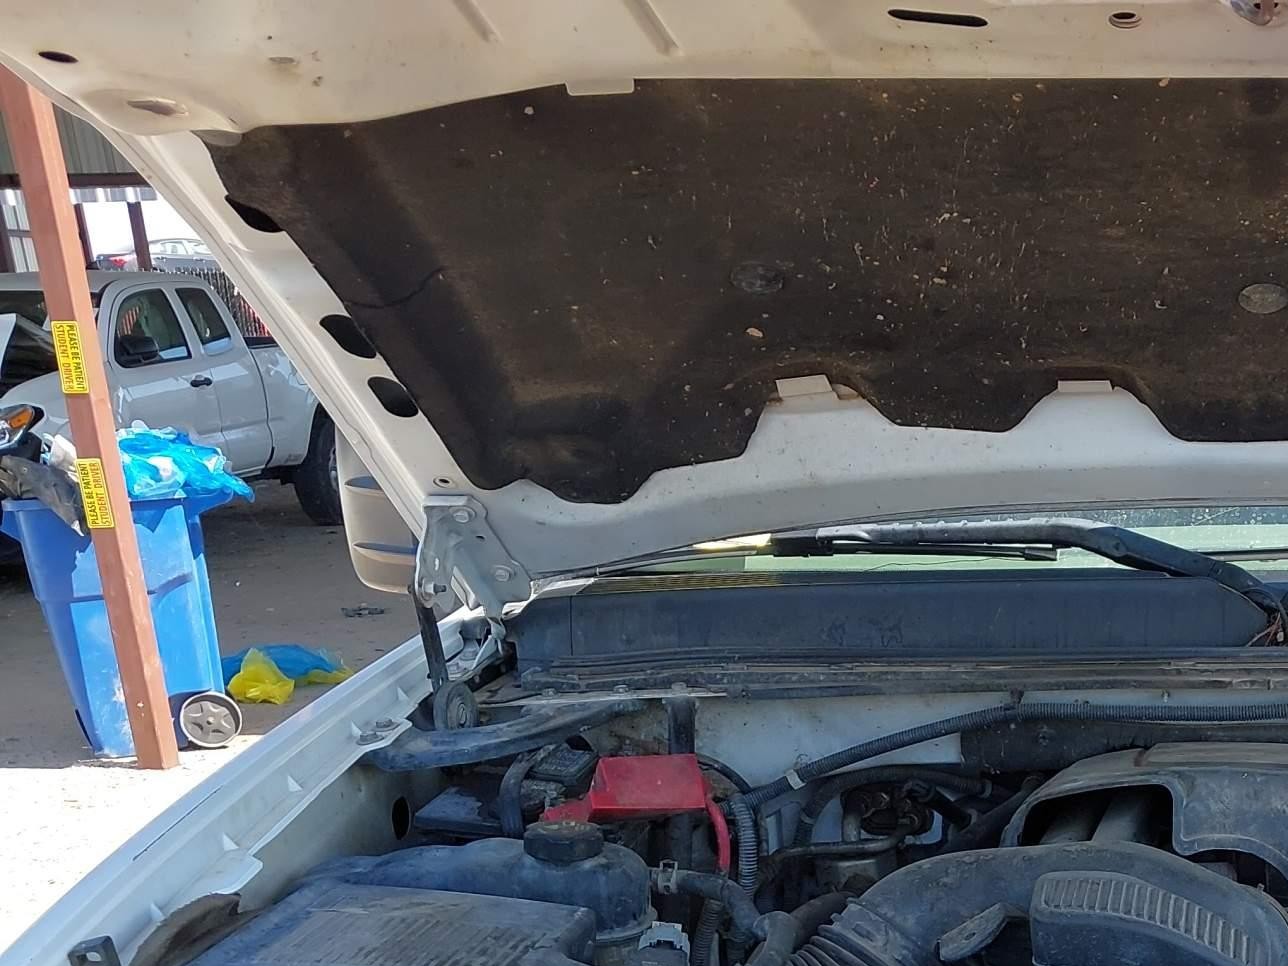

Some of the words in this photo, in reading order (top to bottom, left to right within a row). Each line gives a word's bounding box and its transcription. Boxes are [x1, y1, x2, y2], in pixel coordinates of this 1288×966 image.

[66, 324, 79, 350] PLEASE
[55, 325, 69, 358] STUDENT
[62, 363, 75, 390] DRIVER
[71, 351, 80, 361] BE
[72, 362, 85, 390] PATIENT
[78, 463, 91, 490] PATIENT
[89, 462, 103, 488] DRIVER
[85, 491, 94, 499] BE
[87, 502, 100, 525] PLEASE
[96, 492, 110, 525] STUDENT
